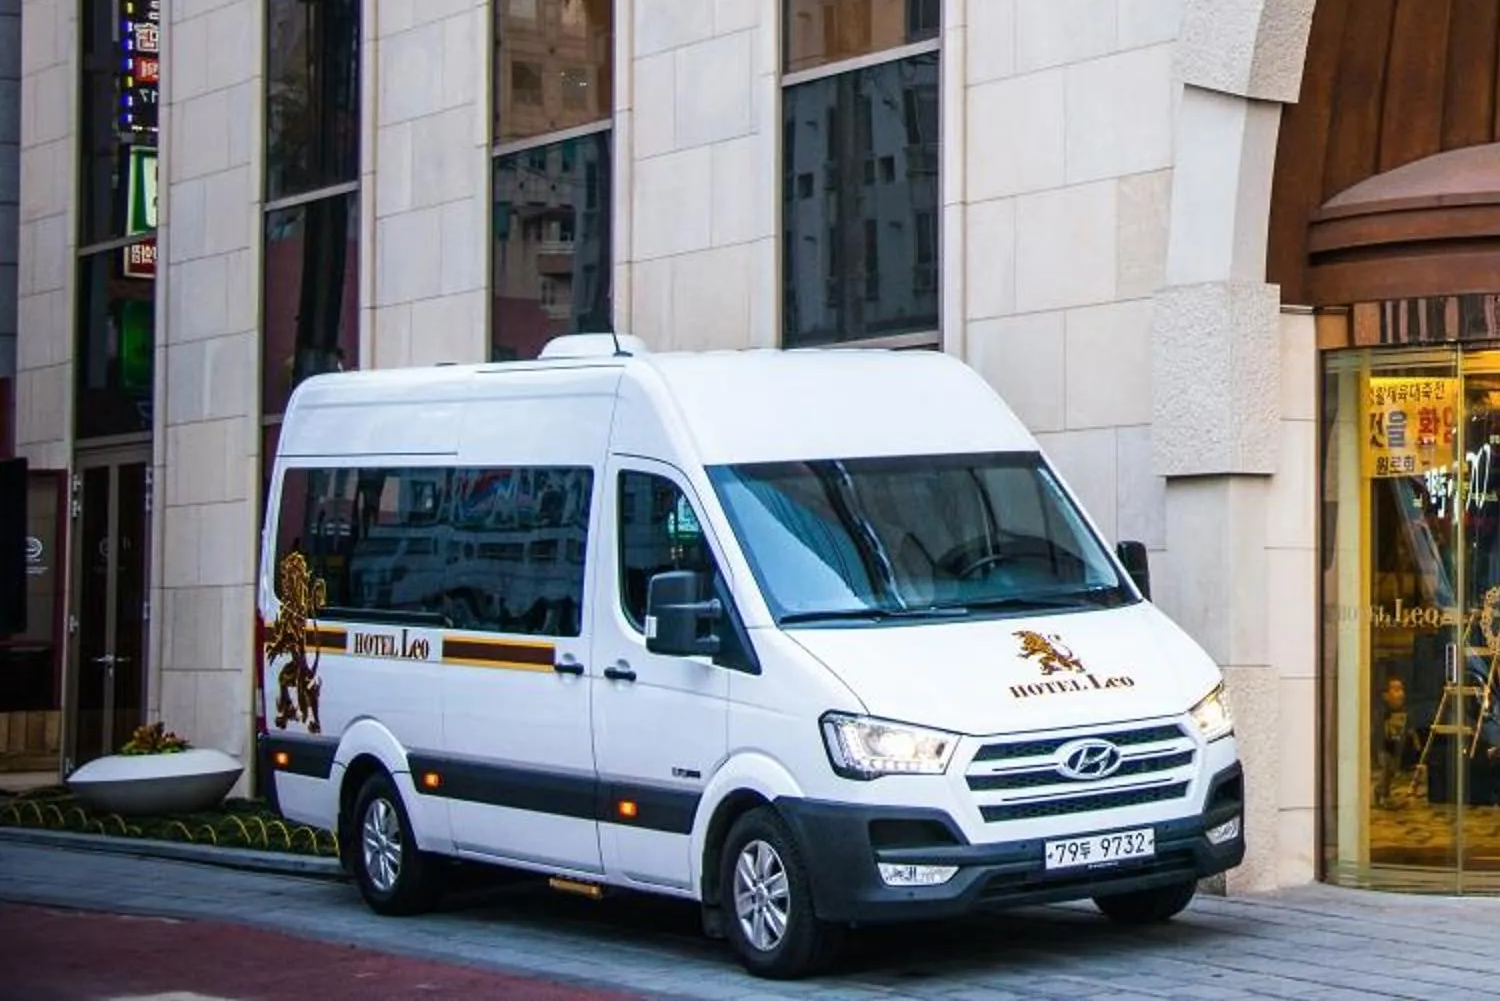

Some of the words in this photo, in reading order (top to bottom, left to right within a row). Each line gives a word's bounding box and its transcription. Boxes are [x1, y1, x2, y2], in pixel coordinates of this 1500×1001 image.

[354, 632, 398, 656] HOTEL
[401, 628, 430, 659] Leo
[1009, 680, 1088, 698] HOTEL
[1086, 674, 1135, 689] Leo
[1101, 832, 1145, 858] 9732
